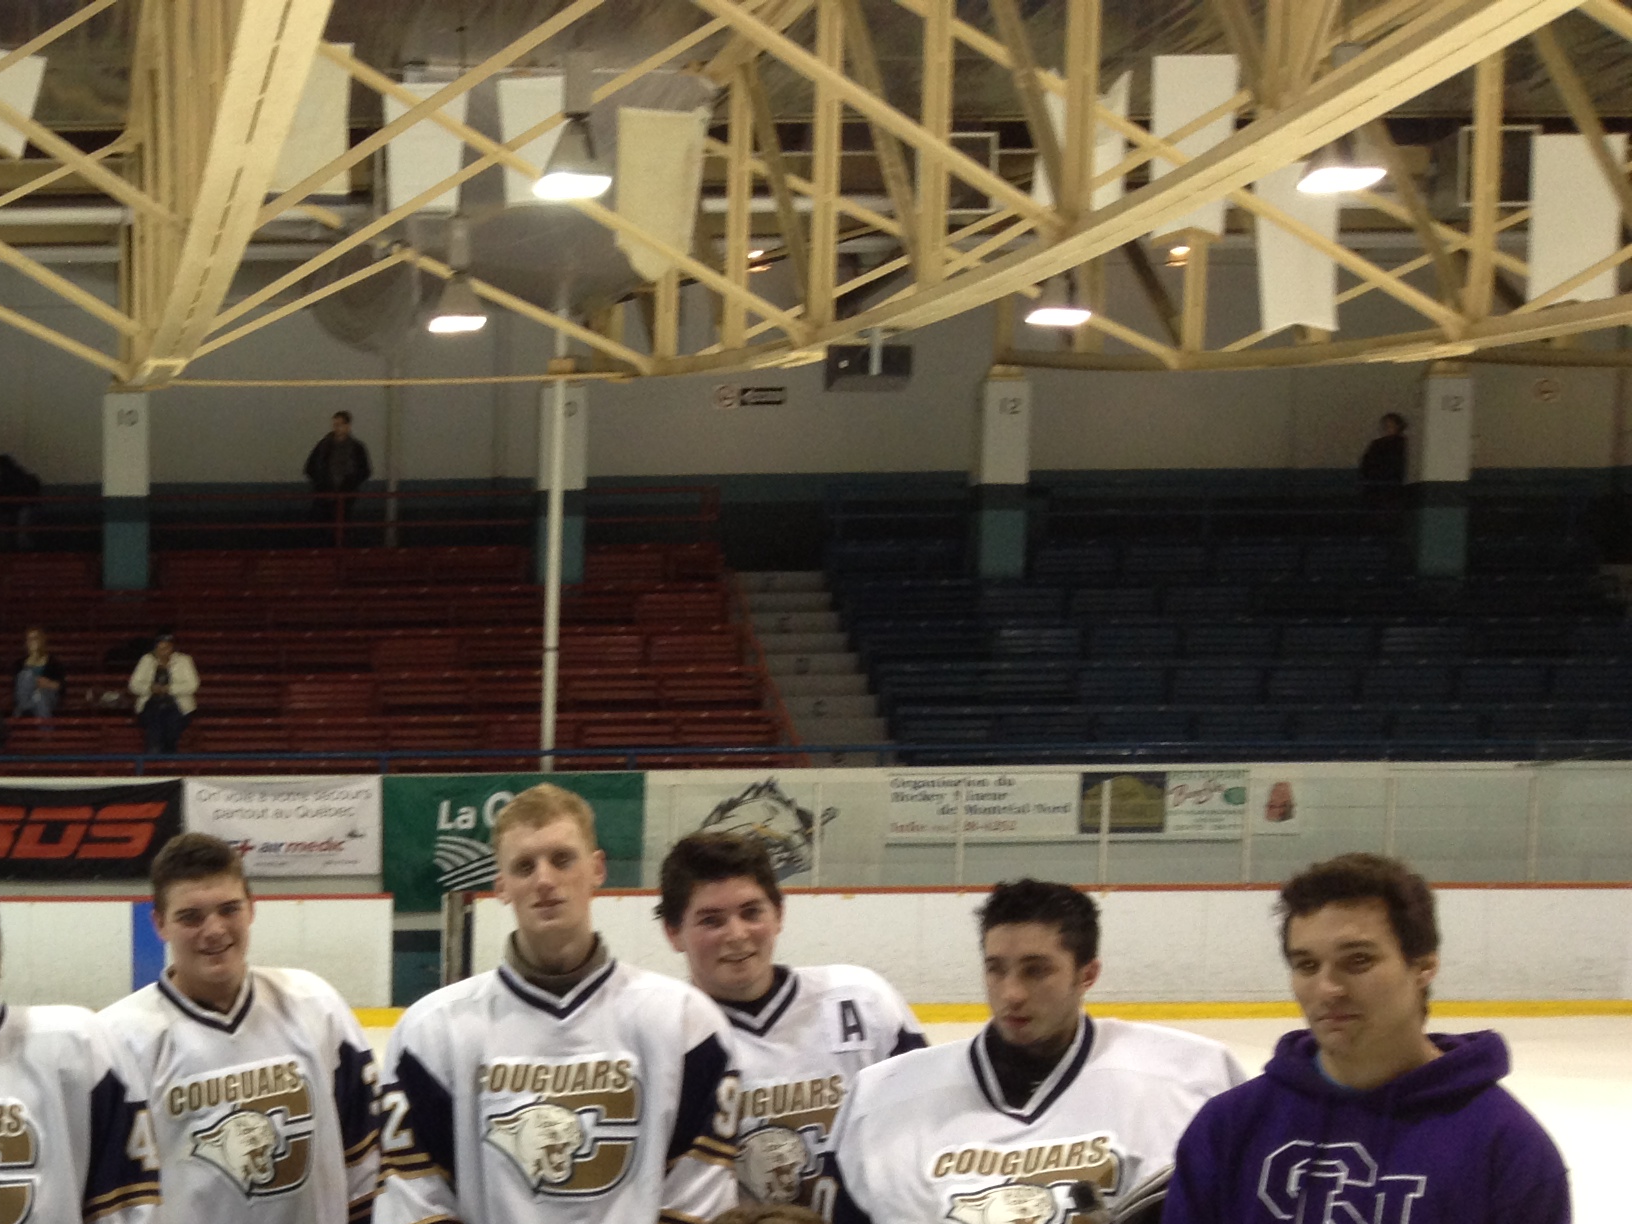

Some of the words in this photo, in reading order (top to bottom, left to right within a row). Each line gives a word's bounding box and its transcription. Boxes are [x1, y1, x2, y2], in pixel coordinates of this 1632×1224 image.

[436, 799, 477, 831] La
[842, 1000, 866, 1043] A
[168, 1060, 305, 1116] COUGUARS
[931, 1136, 1110, 1178] COUGUARS
